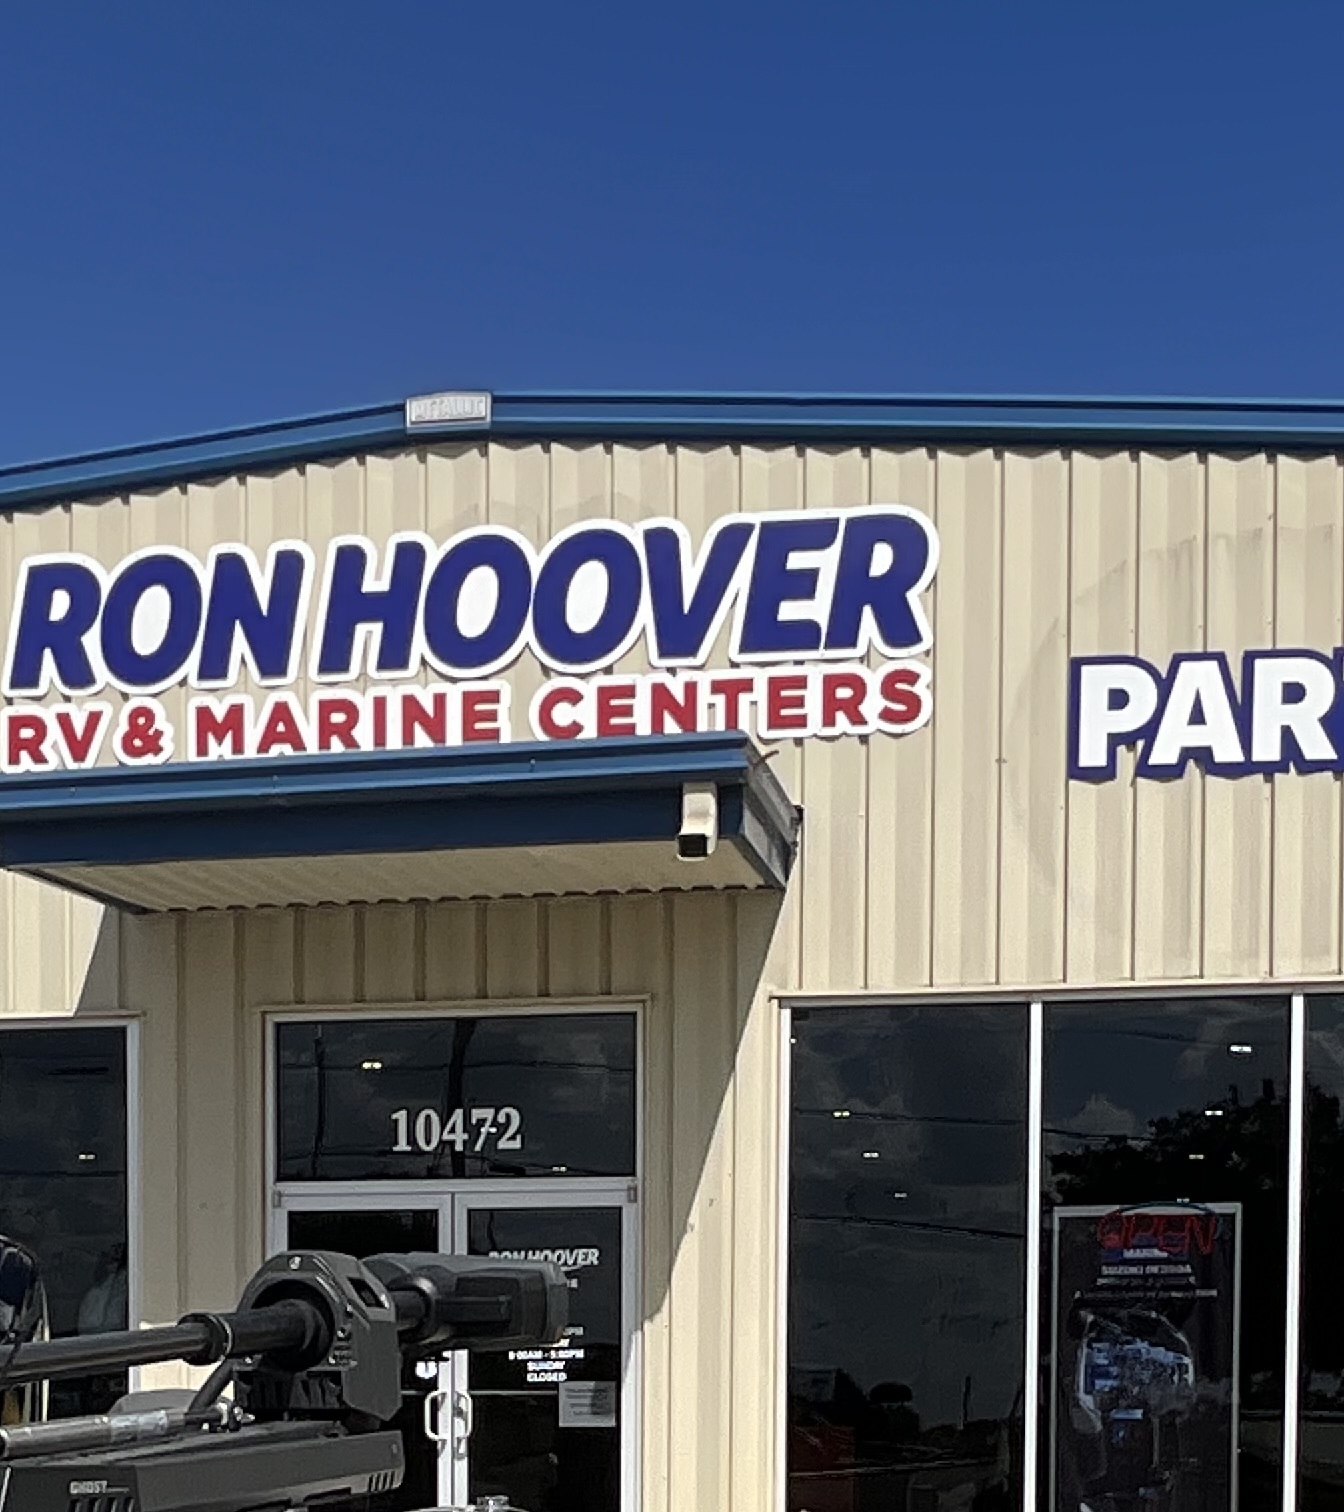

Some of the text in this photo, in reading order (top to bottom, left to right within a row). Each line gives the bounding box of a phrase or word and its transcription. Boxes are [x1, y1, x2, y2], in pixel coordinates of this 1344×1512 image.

[9, 513, 930, 691] RON HOOVER
[7, 668, 923, 767] RV & MARINE CENTERS
[390, 1106, 522, 1152] 10472
[1097, 1210, 1217, 1255] OPEN
[527, 1248, 600, 1265] HOOVER
[526, 1372, 567, 1382] CLOSED
